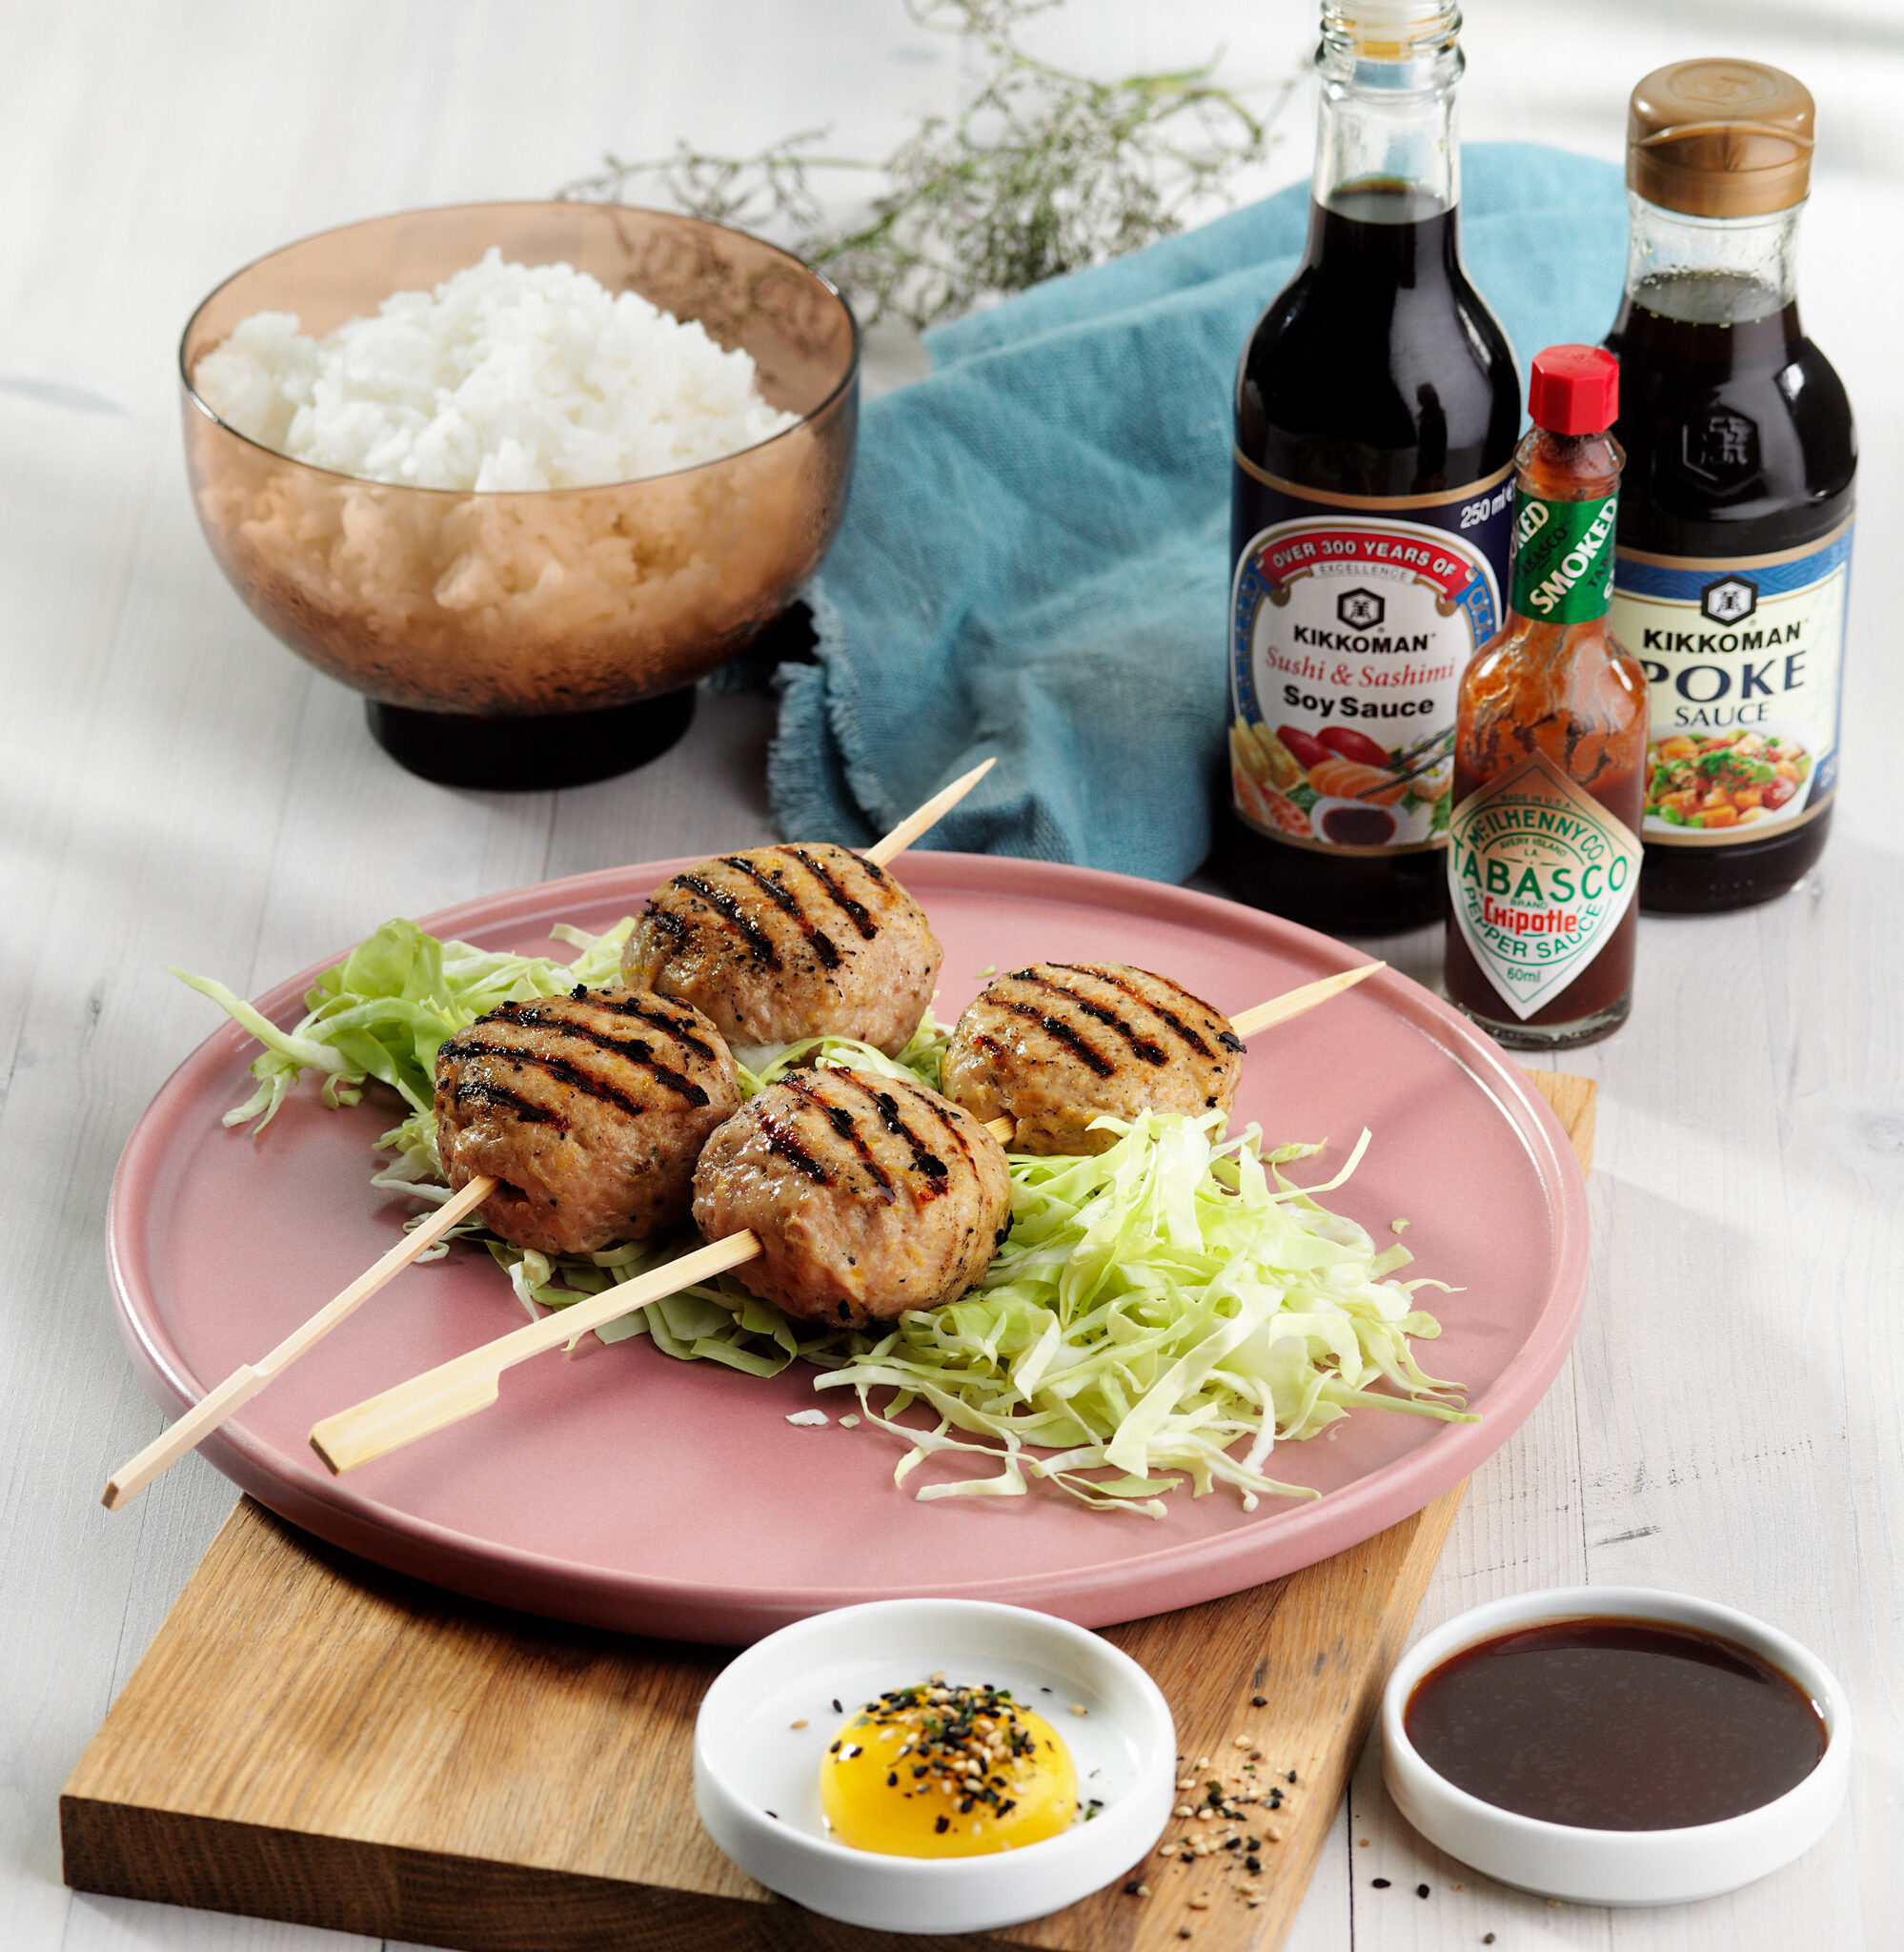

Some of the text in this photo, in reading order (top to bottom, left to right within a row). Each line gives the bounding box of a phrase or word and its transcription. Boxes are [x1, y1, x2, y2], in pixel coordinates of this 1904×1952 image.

[1460, 498, 1490, 529] 250
[1491, 486, 1506, 516] ml
[1272, 540, 1457, 578] OVER 300 YEARS OF
[1319, 562, 1408, 581] EXCELLENCE
[1529, 498, 1617, 615] SMOKED
[1293, 624, 1428, 654] KIKKOMAN
[1643, 620, 1801, 654] KIKKOMAN
[1265, 644, 1456, 688] Sushi & Sashimi
[1639, 650, 1807, 703] POKE
[1283, 684, 1434, 719] Soy Sauce
[1674, 701, 1770, 727] SAUCE
[1500, 837, 1568, 858] AVERY ISLAND
[1452, 834, 1628, 904] TABASCO
[1464, 886, 1601, 958] PEPPER SAUCE
[1509, 899, 1549, 910] BRAND
[1507, 966, 1542, 984] 60ml
